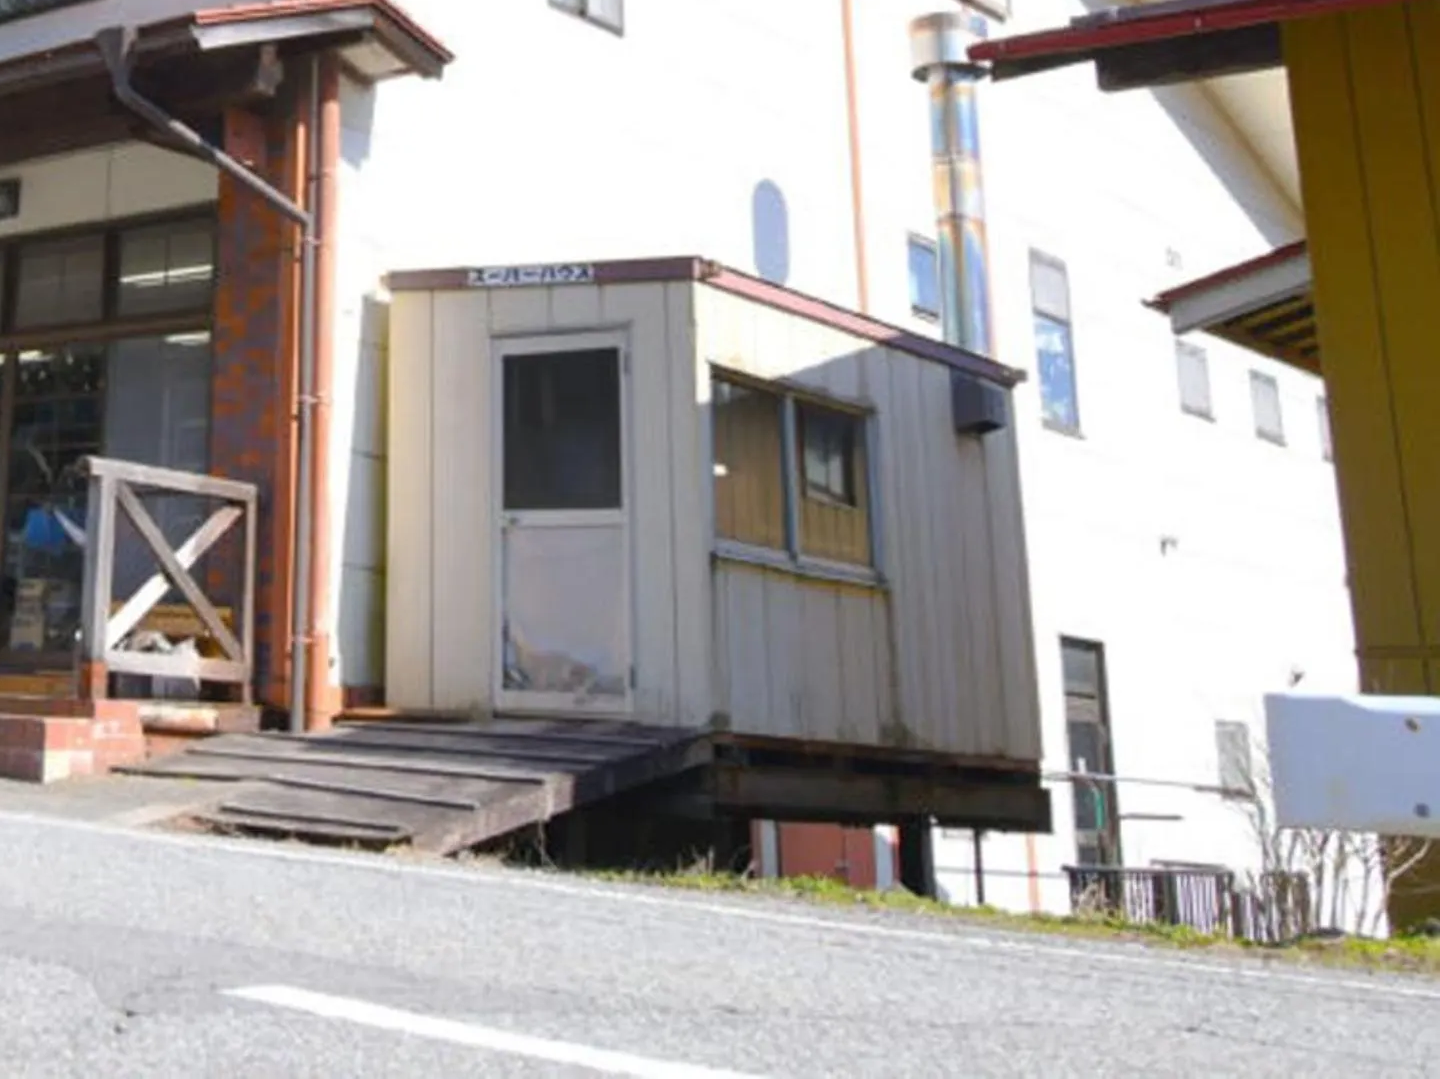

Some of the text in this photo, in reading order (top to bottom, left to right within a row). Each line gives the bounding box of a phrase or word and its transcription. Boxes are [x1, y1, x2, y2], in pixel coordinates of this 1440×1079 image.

[472, 264, 589, 283] スーパーハウス
